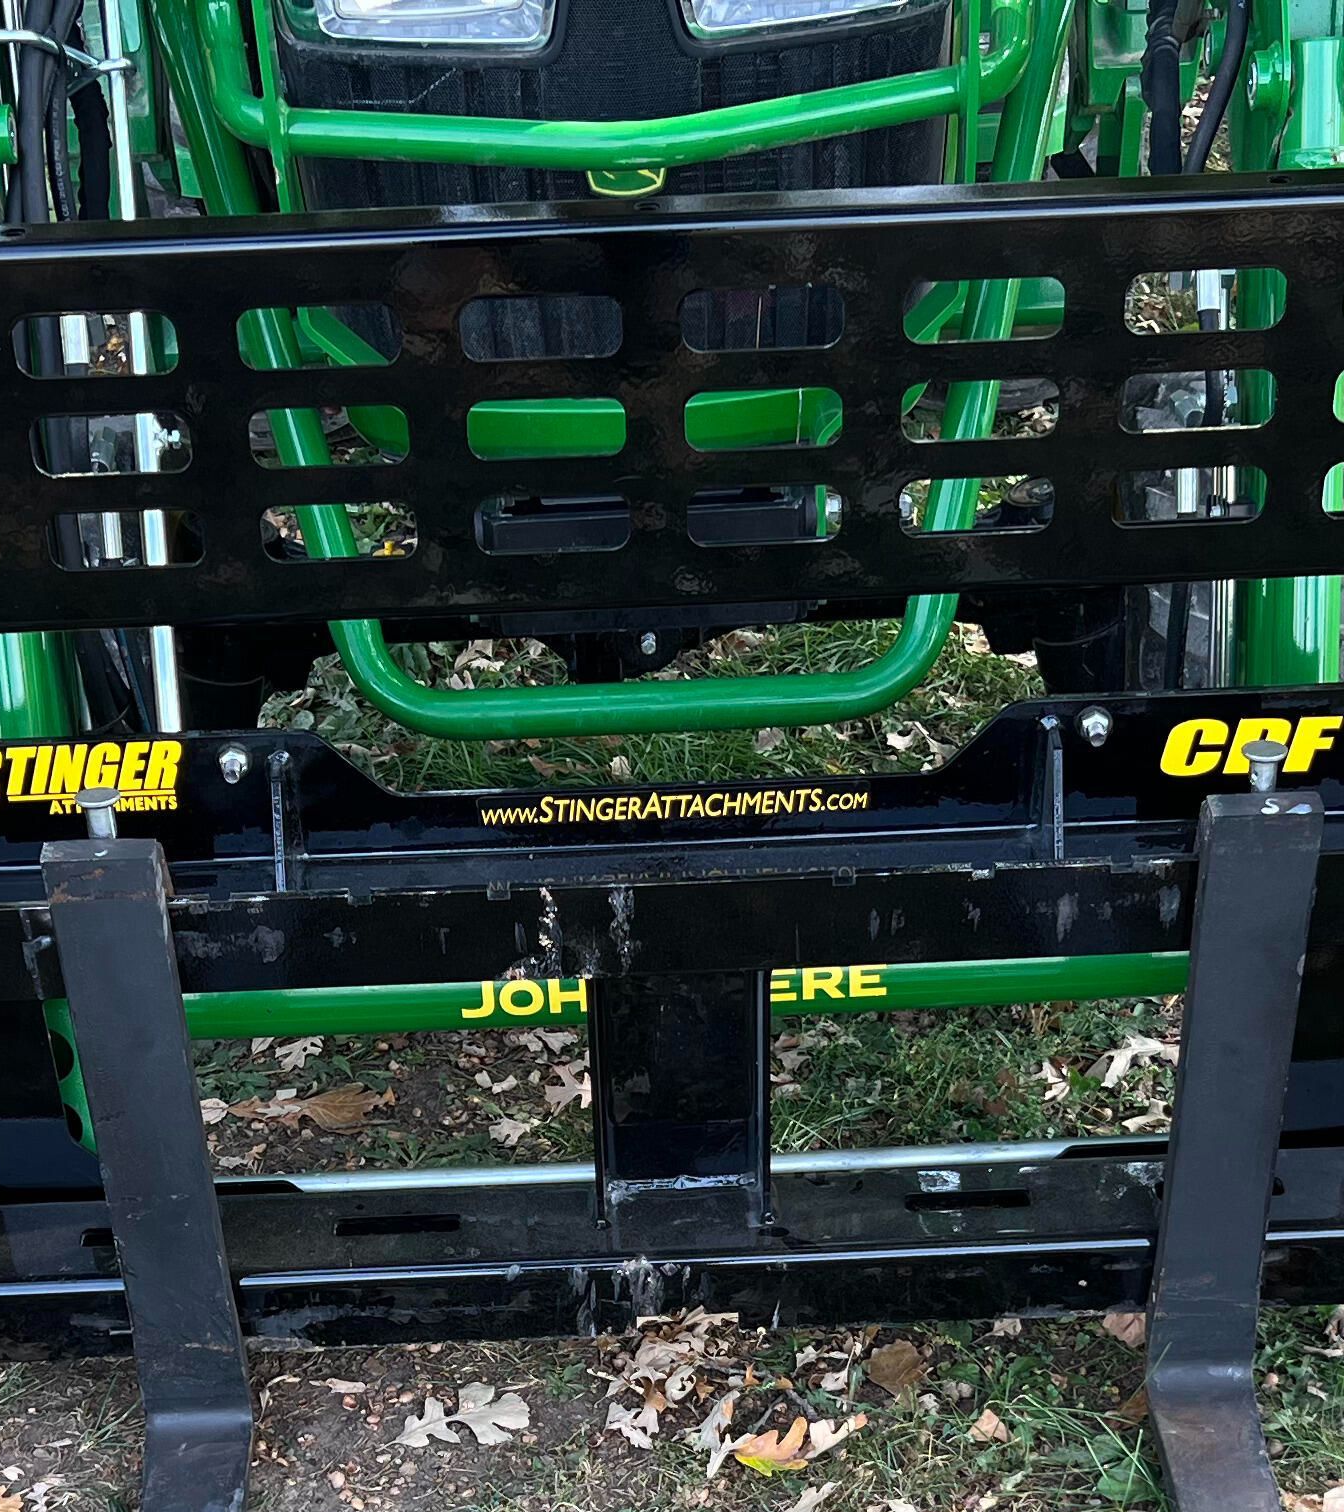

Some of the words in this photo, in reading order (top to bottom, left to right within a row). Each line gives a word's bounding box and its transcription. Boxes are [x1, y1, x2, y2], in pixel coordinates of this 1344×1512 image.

[1160, 716, 1344, 776] CPF
[461, 978, 588, 1018] JOH
[770, 964, 887, 1002] ERE
